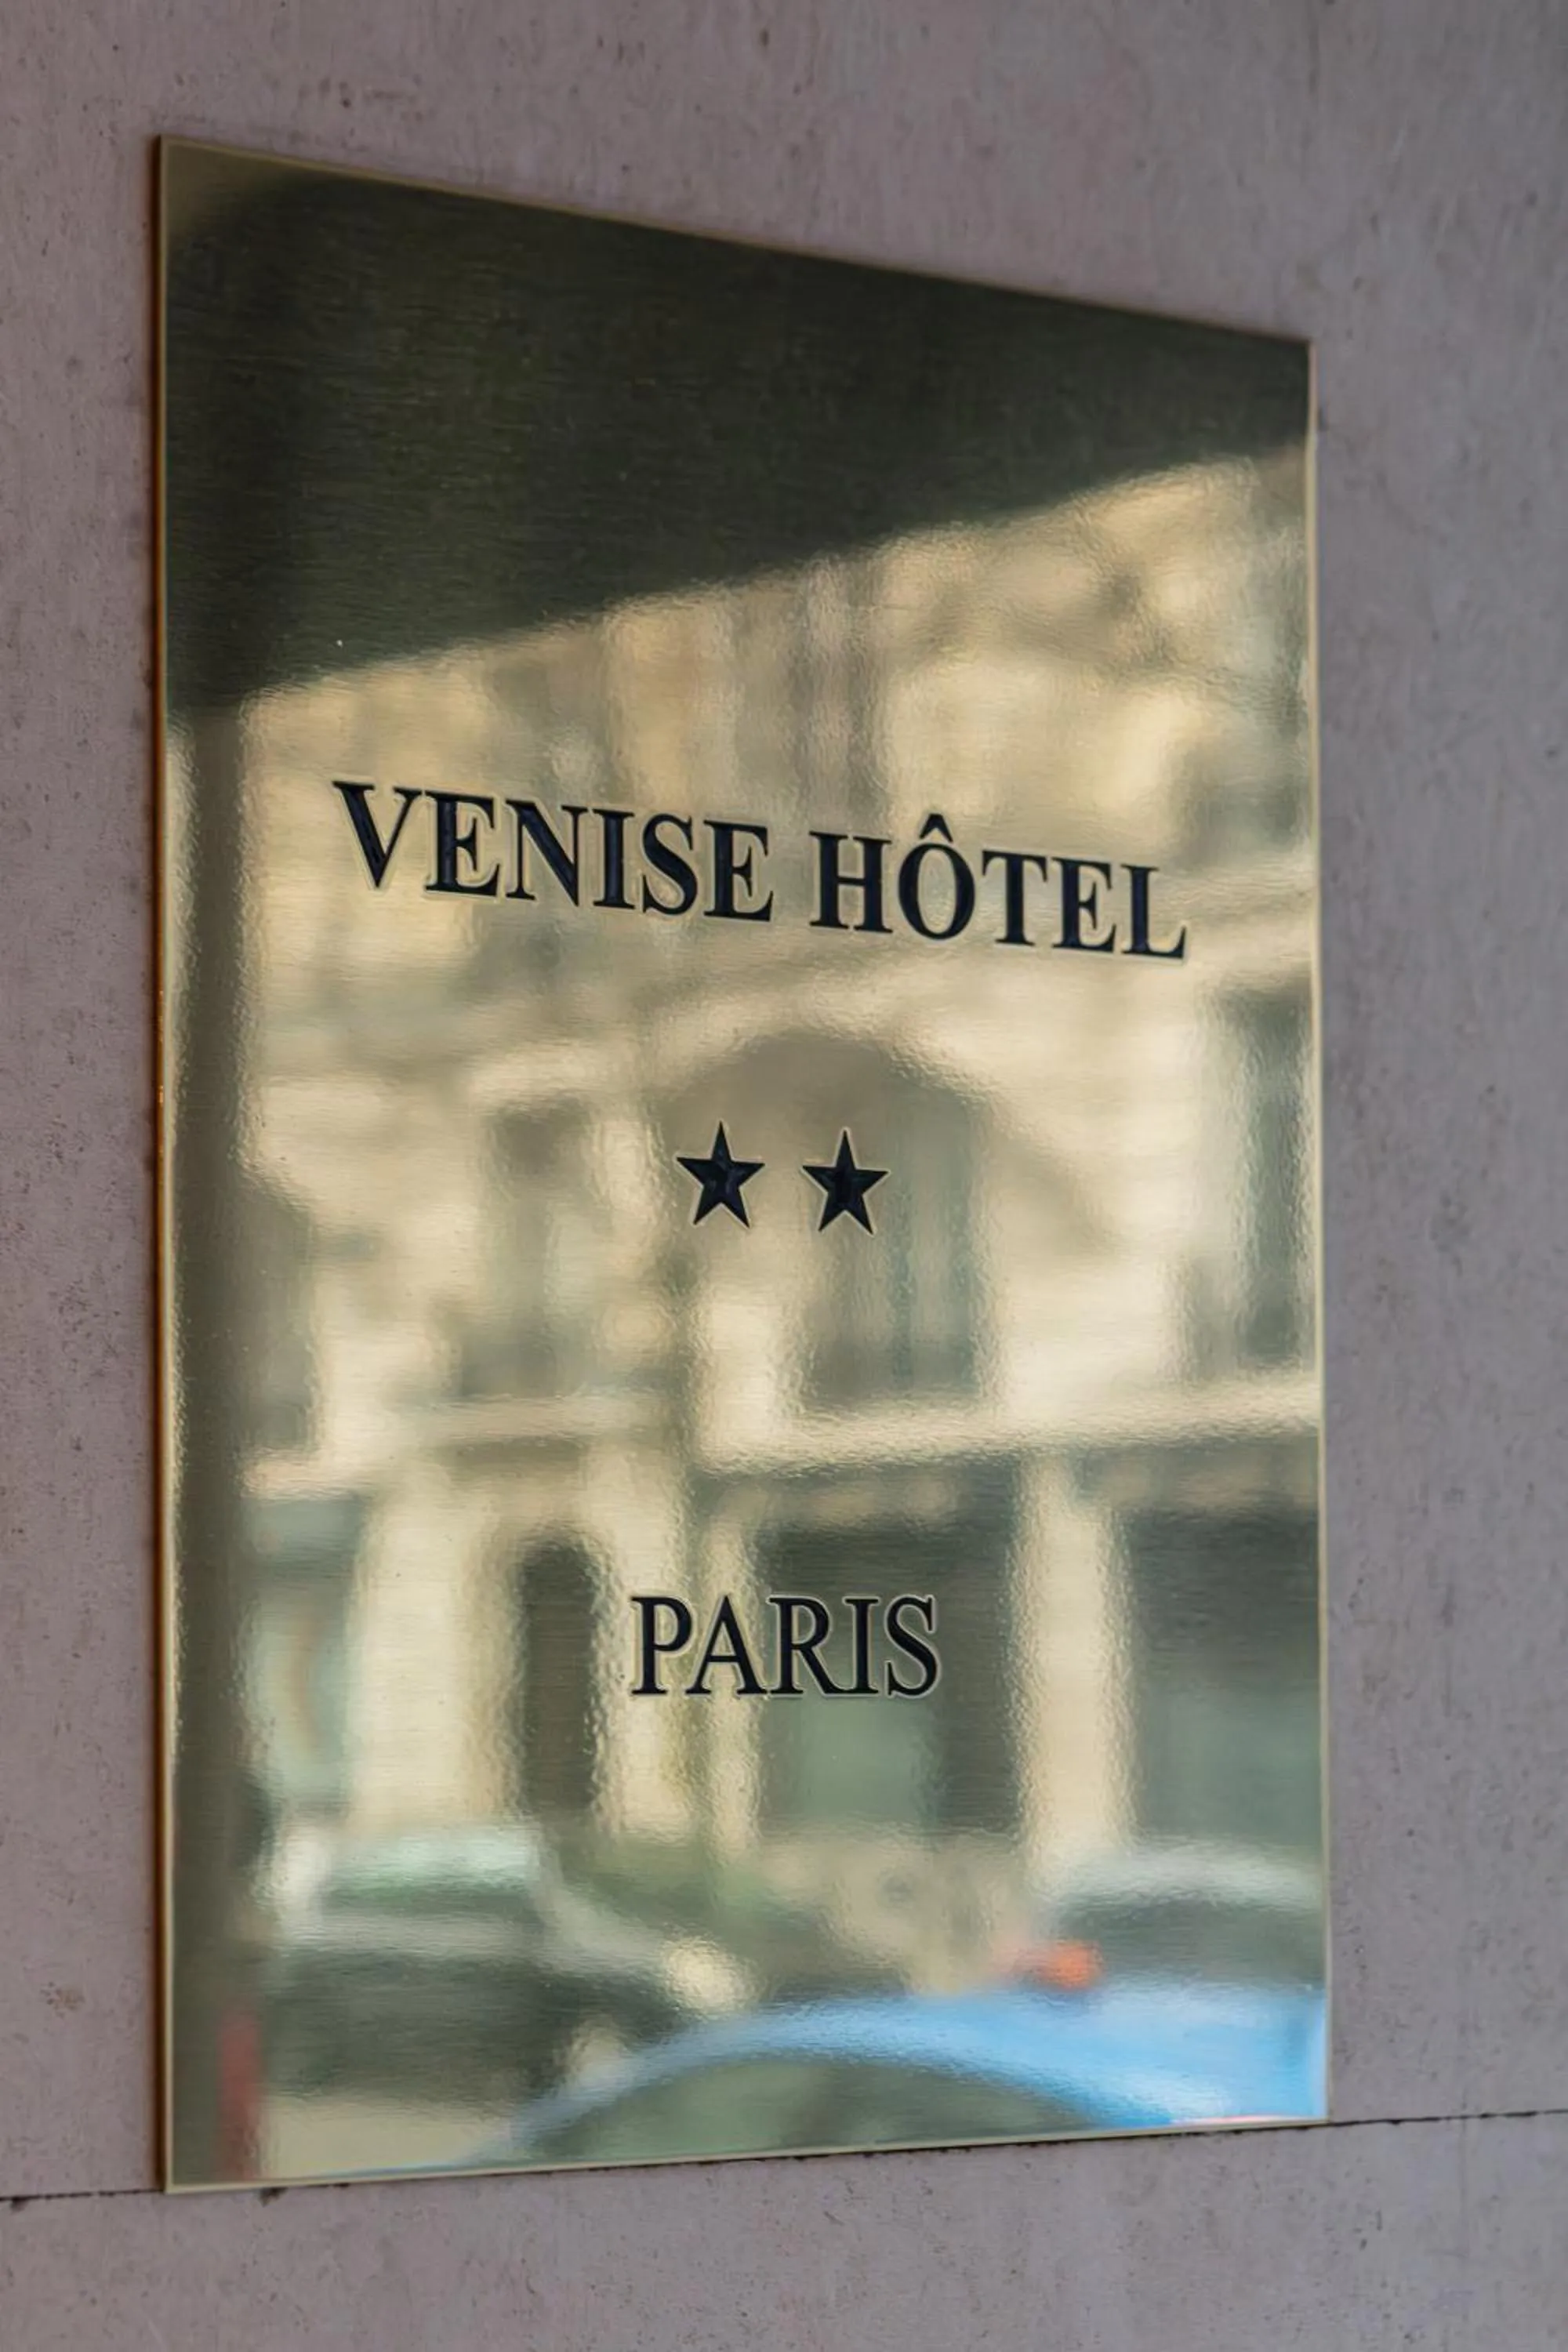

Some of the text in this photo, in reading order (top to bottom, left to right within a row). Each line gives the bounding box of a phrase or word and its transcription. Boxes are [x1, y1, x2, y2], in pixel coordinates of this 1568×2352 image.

[332, 781, 1186, 960] VENISE HÔTEL
[630, 1595, 938, 1697] PARIS
